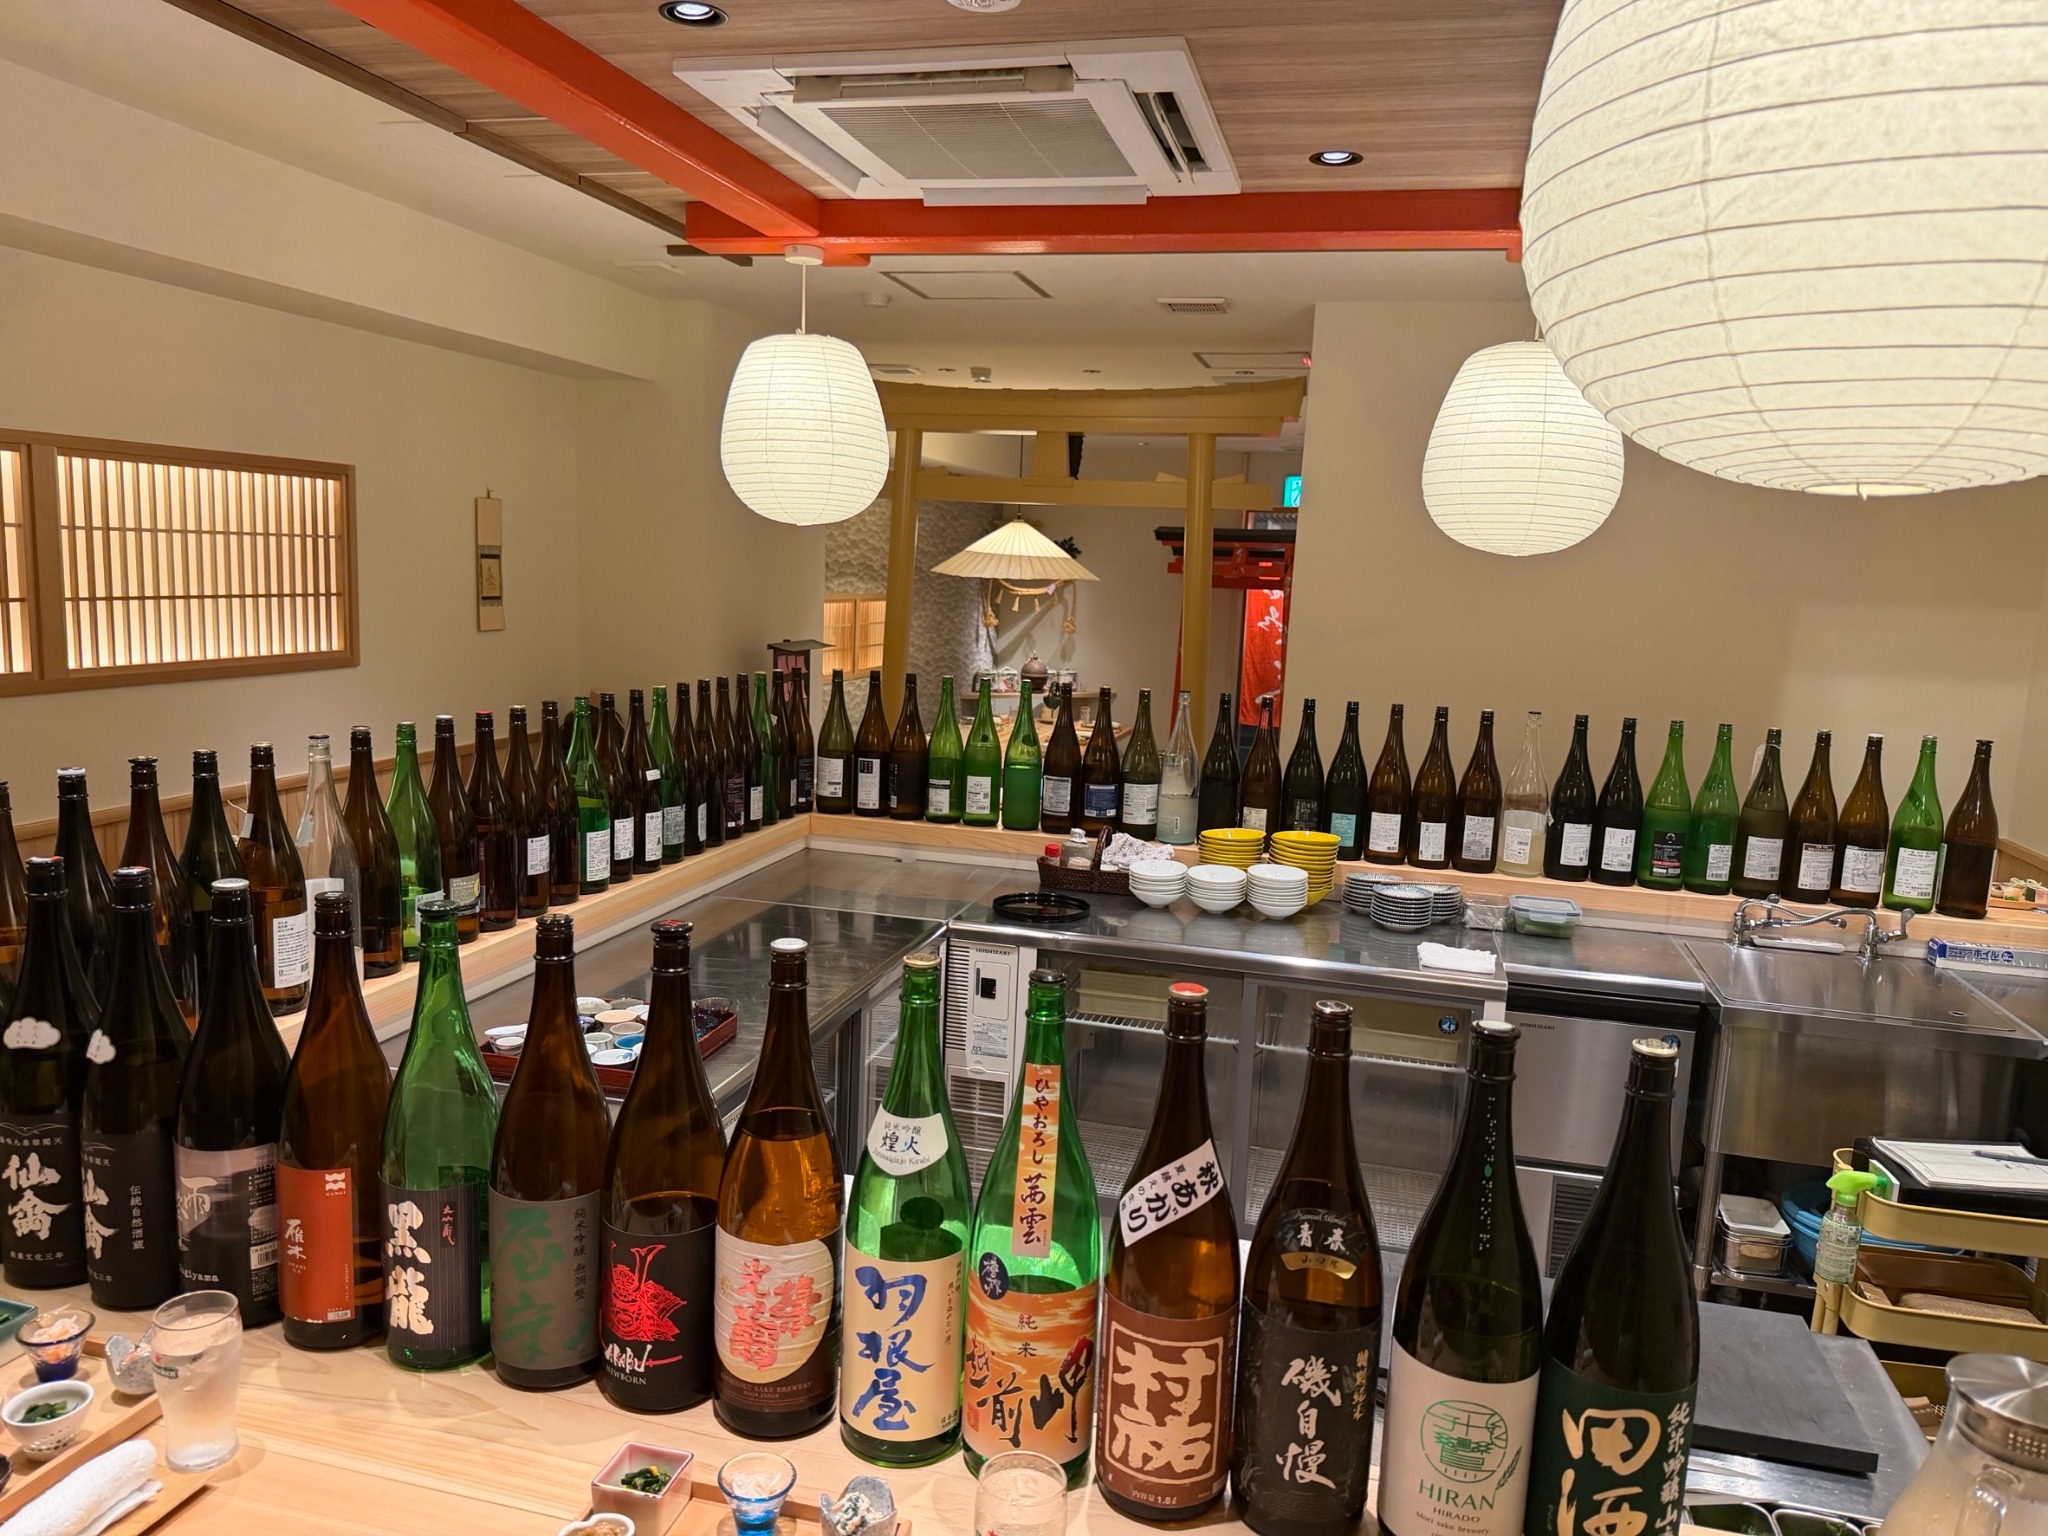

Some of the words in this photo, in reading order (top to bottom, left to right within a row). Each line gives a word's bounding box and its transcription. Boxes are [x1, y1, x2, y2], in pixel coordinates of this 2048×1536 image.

[976, 948, 1010, 956] HOSHIZAKI
[884, 1121, 922, 1137] 純米吟醸
[1032, 1079, 1050, 1165] ひやおろし
[880, 1132, 921, 1155] 煌火
[2, 1152, 73, 1240] 仙禽
[1020, 1172, 1048, 1245] 茜雲
[1127, 1160, 1219, 1233] 秋あがり
[285, 1219, 307, 1260] 雁木
[1297, 1222, 1346, 1251] 青春
[385, 1201, 434, 1335] 黒龍
[852, 1265, 935, 1431] 羽根屋
[1018, 1313, 1039, 1358] 純米
[604, 1343, 653, 1374] AKABU
[605, 1364, 647, 1385] NEWBORN
[777, 1381, 813, 1393] BREWERY
[965, 1334, 1095, 1449] 越前岬
[1113, 1342, 1216, 1474] 村祐
[1276, 1357, 1342, 1490] 磯自慢
[1419, 1479, 1497, 1511] HIRAN
[1433, 1507, 1480, 1523] HIRADO
[1416, 1511, 1434, 1524] Mori
[1437, 1522, 1454, 1531] sake
[1457, 1526, 1490, 1535] brewery
